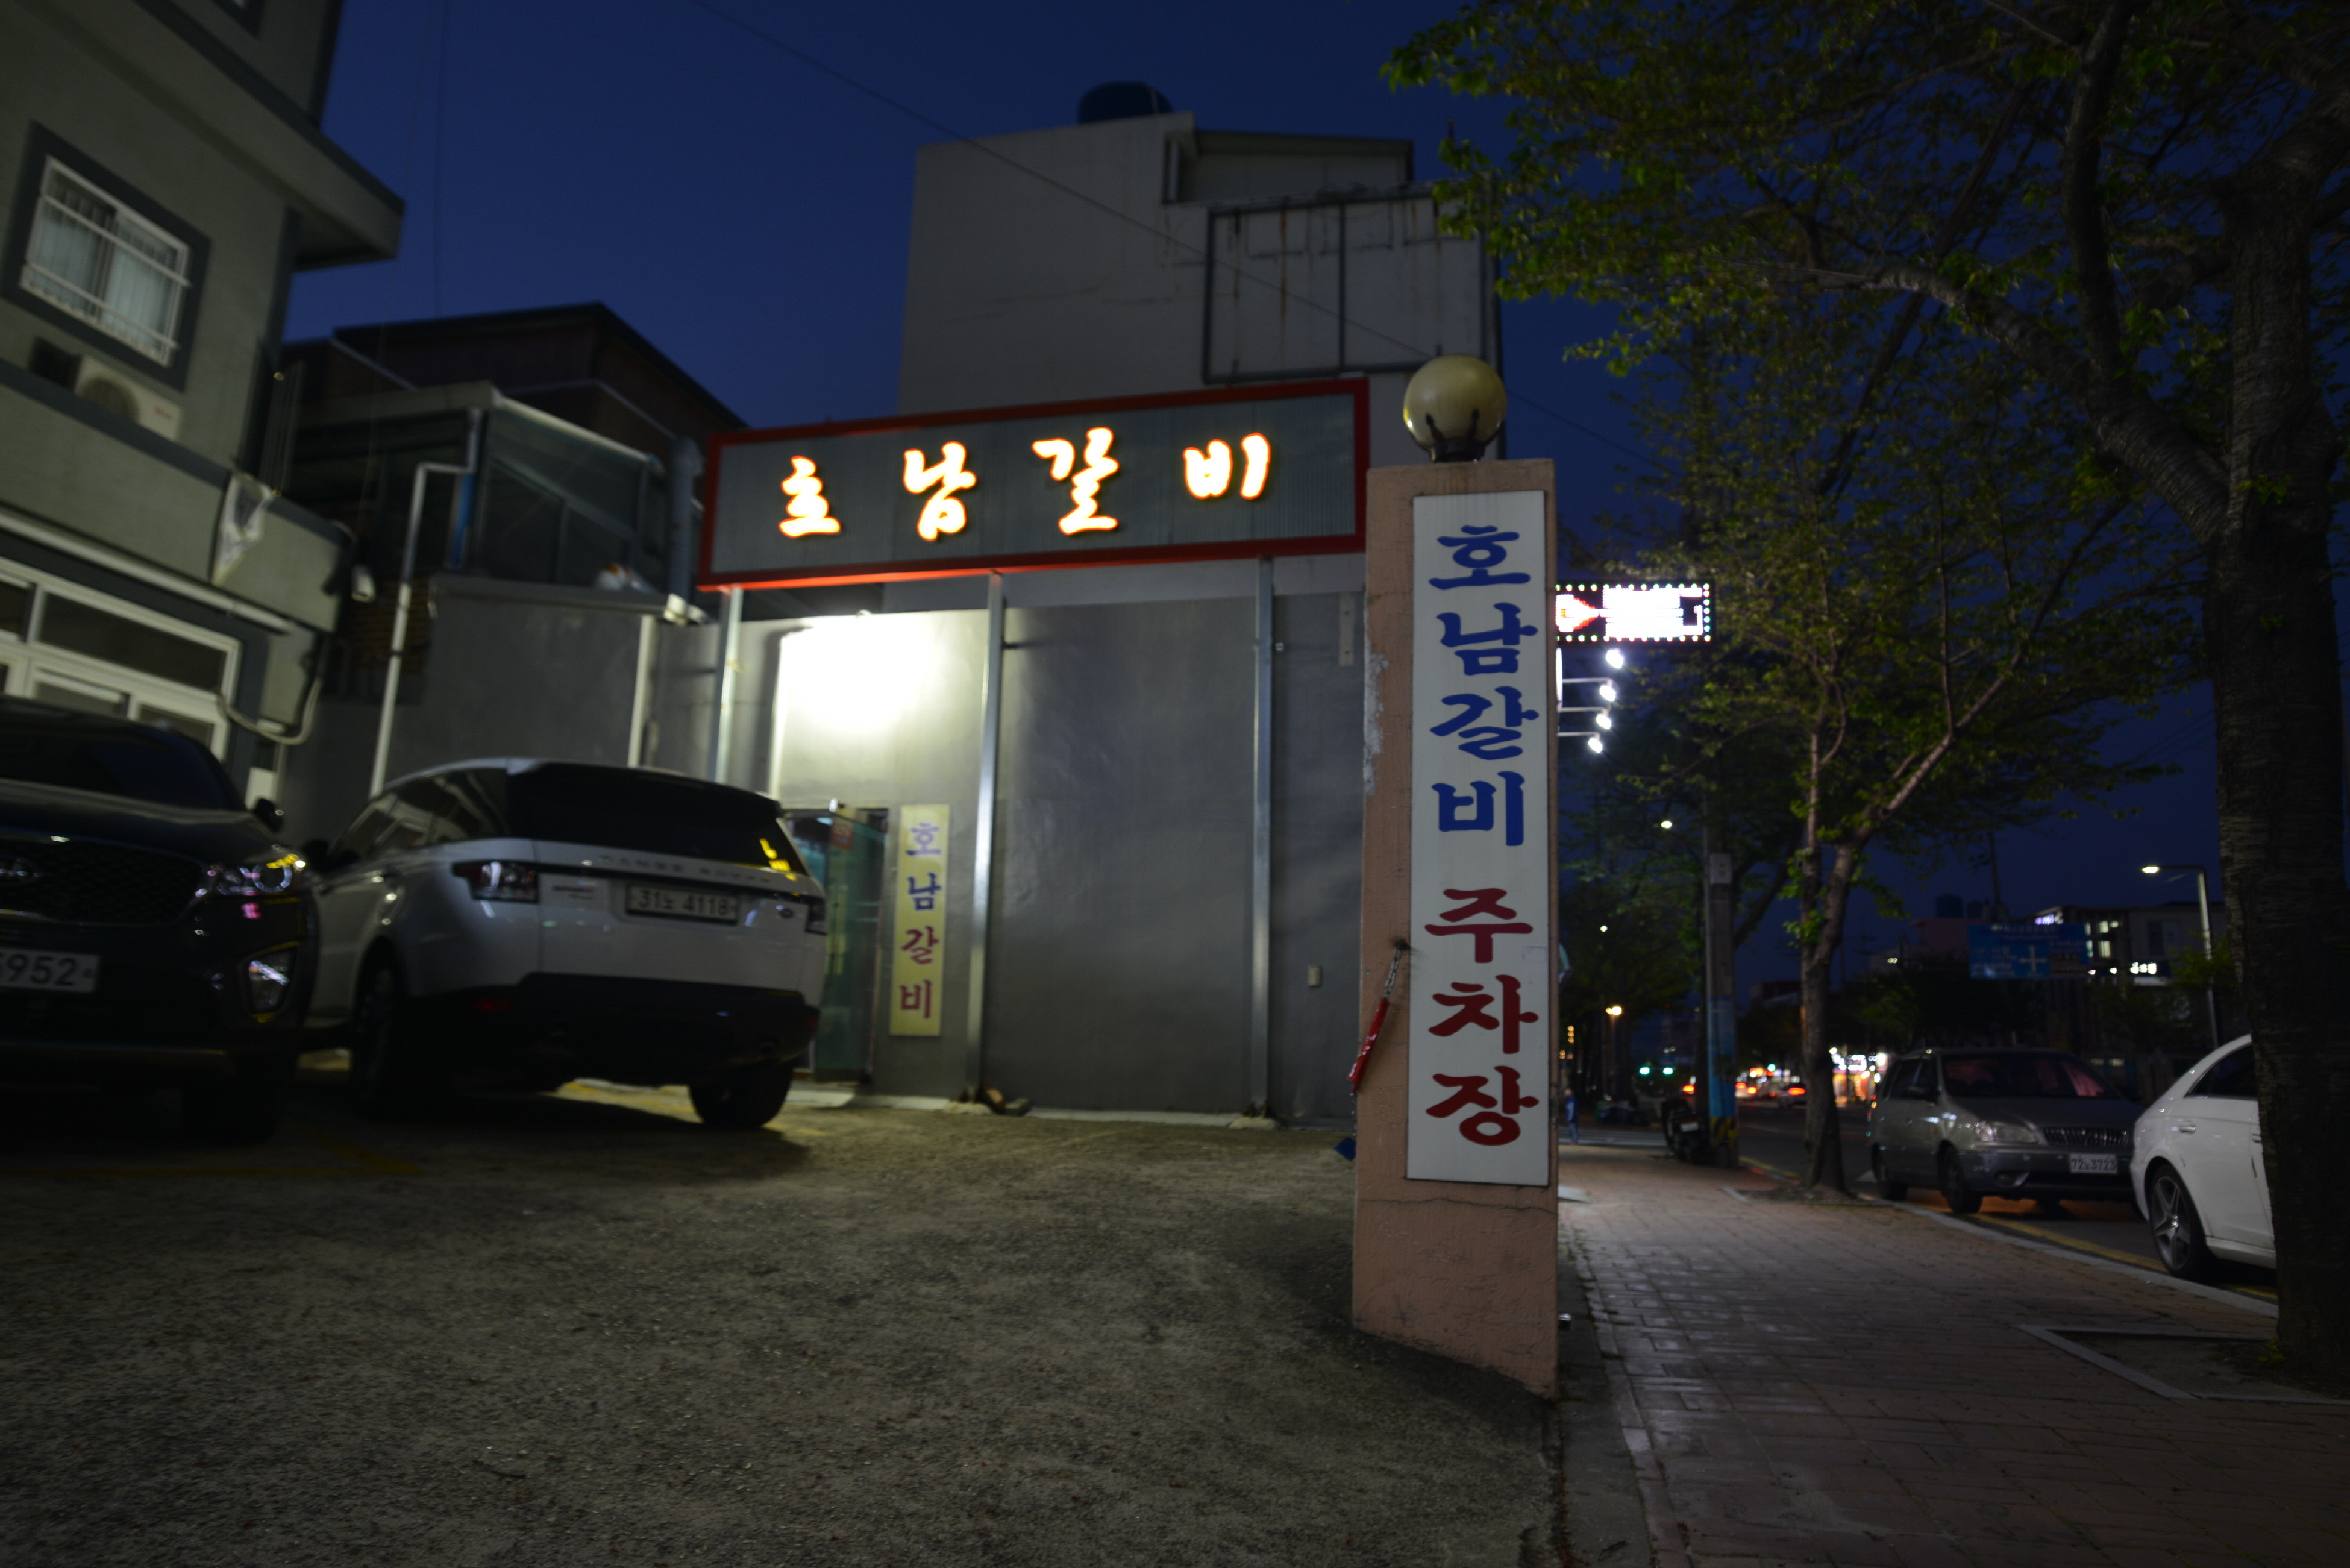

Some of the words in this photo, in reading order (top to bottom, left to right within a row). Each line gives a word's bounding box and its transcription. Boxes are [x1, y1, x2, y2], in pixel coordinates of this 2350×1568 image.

[779, 426, 1271, 541] 호남갈비
[1429, 524, 1539, 846] 호남갈비
[0, 953, 78, 986] 952
[899, 822, 942, 1019] 호남갈비
[1424, 888, 1540, 1146] 주차장
